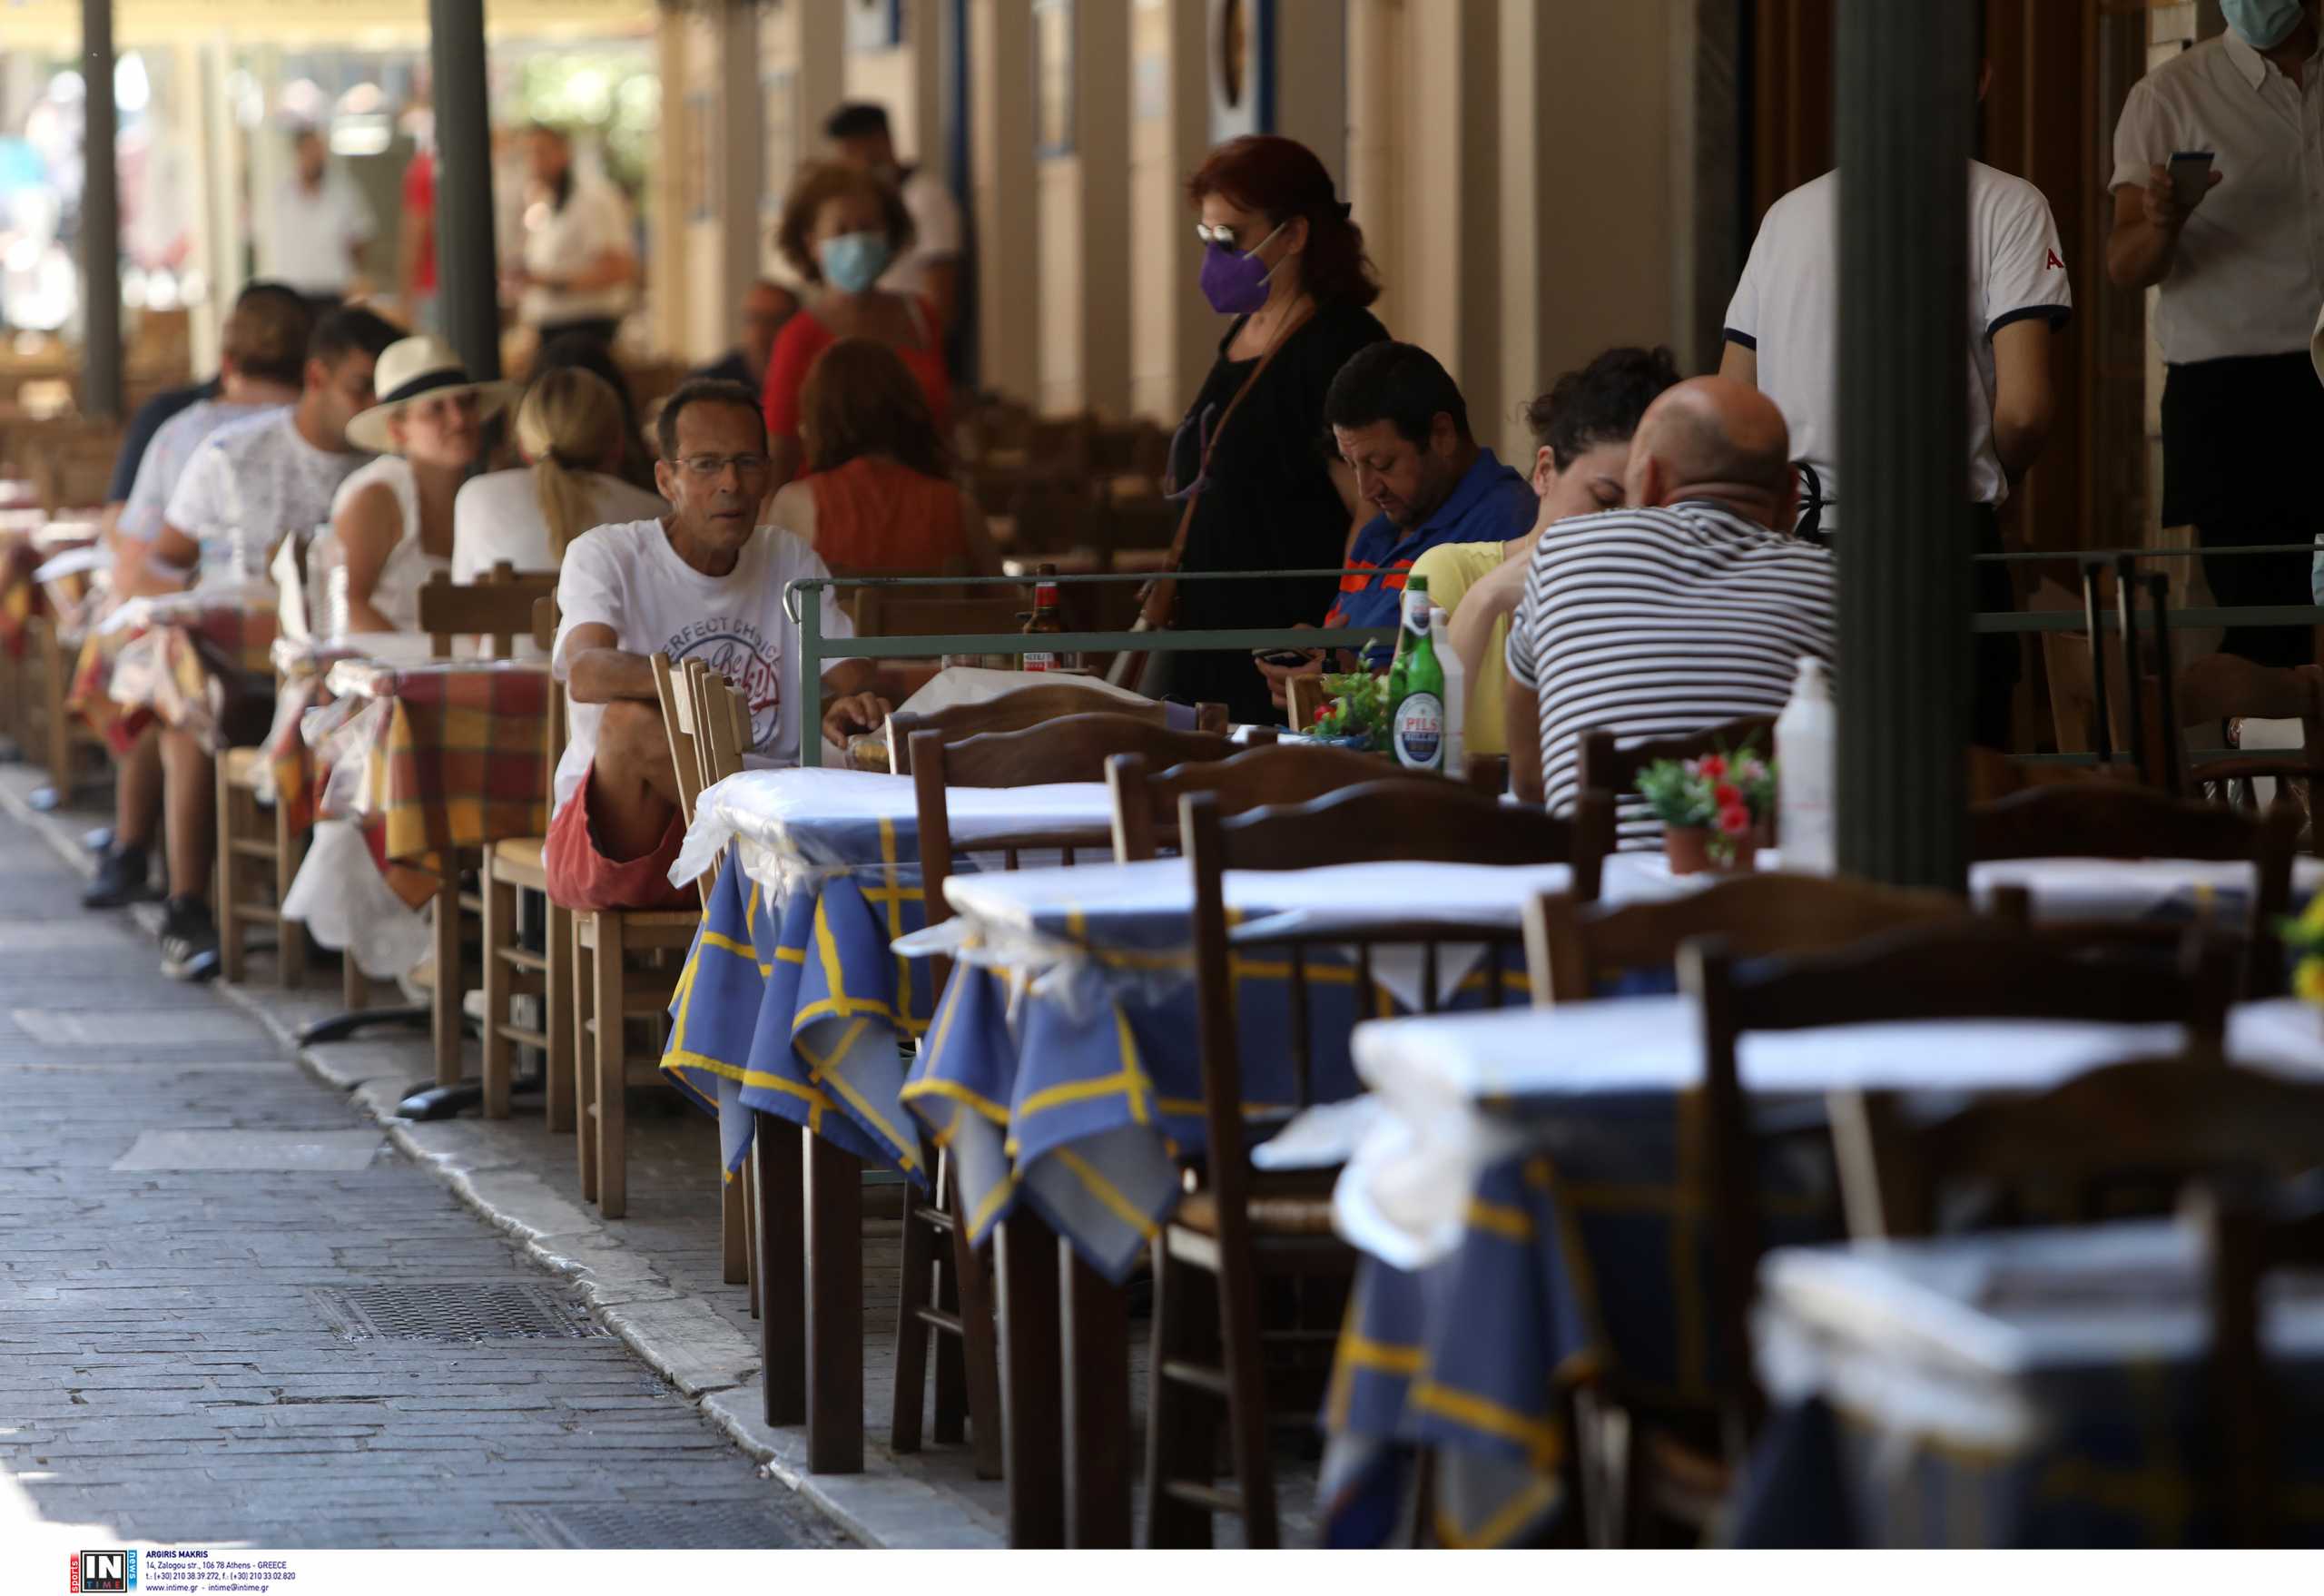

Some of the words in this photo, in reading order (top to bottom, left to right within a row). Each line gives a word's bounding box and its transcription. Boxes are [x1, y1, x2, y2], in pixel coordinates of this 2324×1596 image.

[2046, 248, 2063, 270] A
[662, 617, 729, 661] ERFECT
[713, 642, 743, 675] Be
[1405, 717, 1438, 732] PILS
